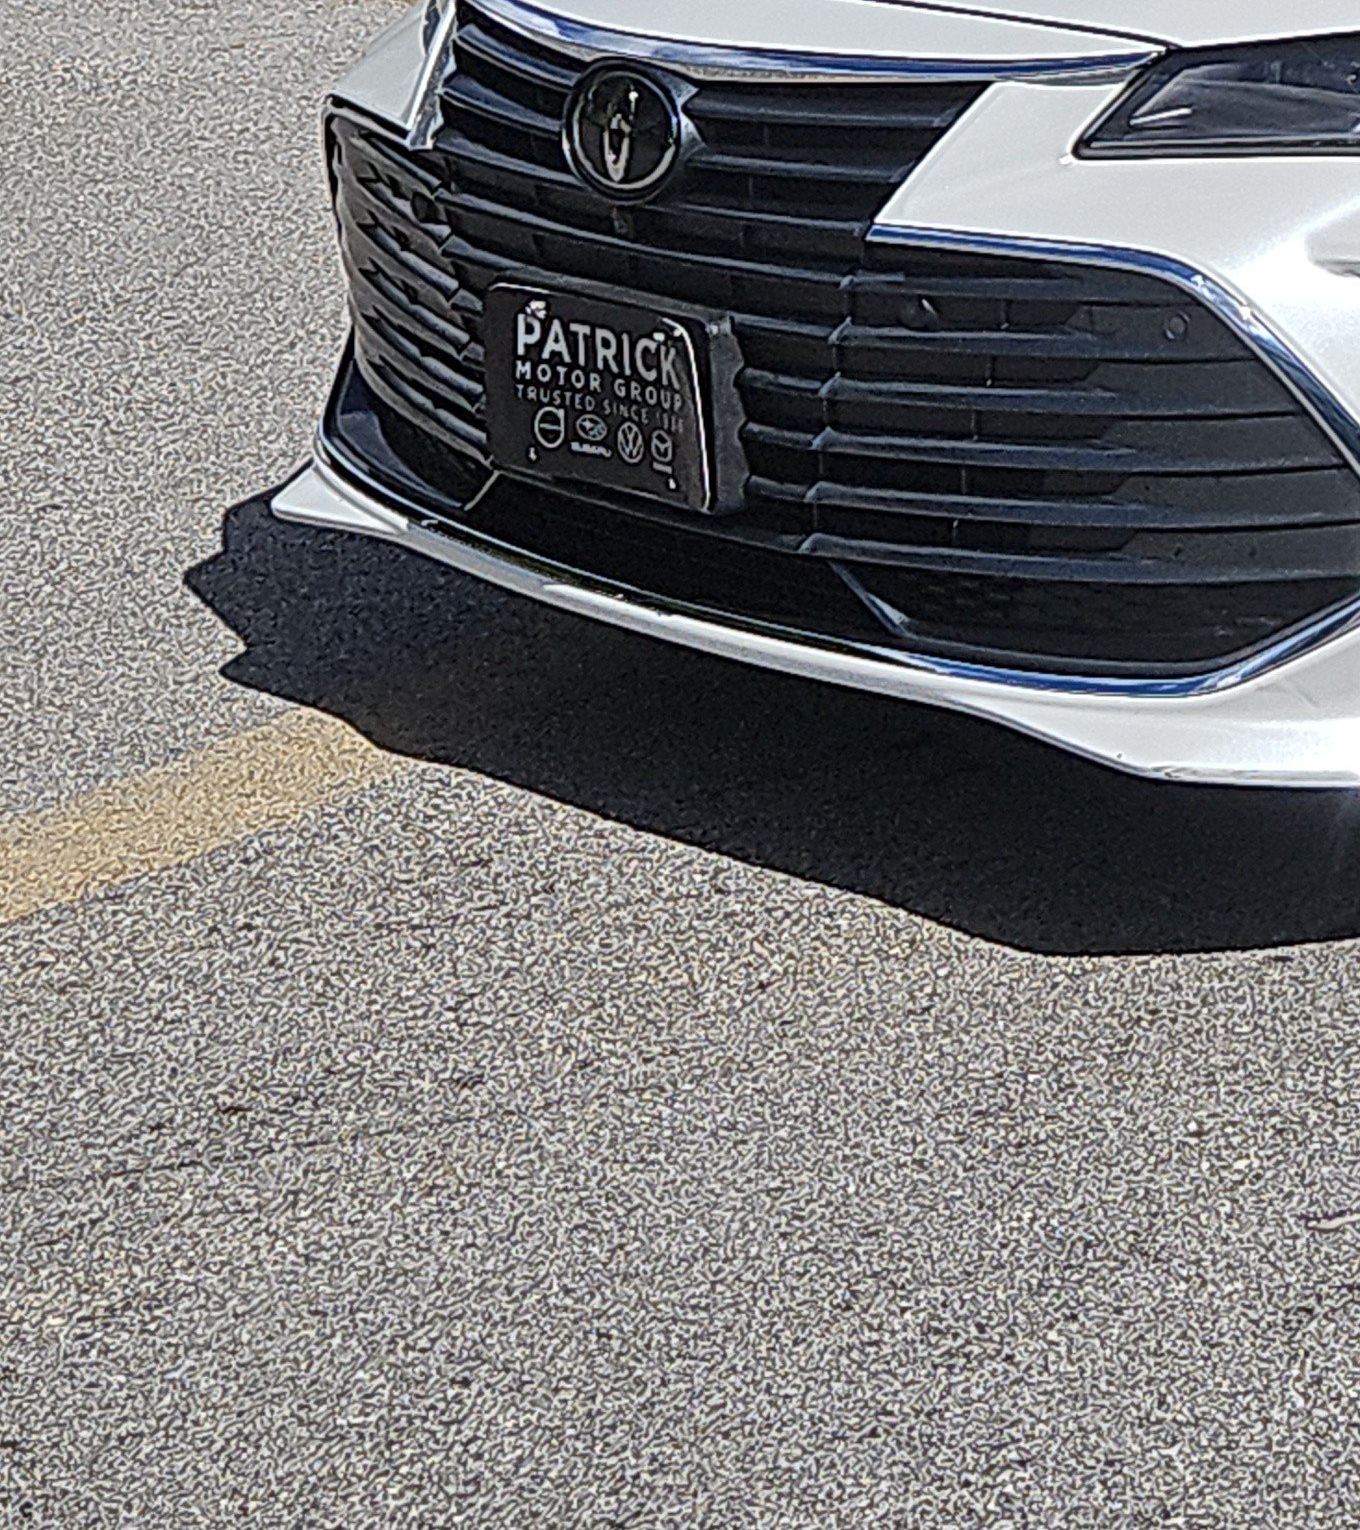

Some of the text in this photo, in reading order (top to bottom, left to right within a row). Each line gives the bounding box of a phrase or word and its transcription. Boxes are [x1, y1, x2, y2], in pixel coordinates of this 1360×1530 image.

[516, 313, 680, 390] PATRICK
[515, 360, 682, 412] MOTOR GROUP
[515, 384, 596, 411] TRUSTED
[602, 399, 650, 425] SINCE
